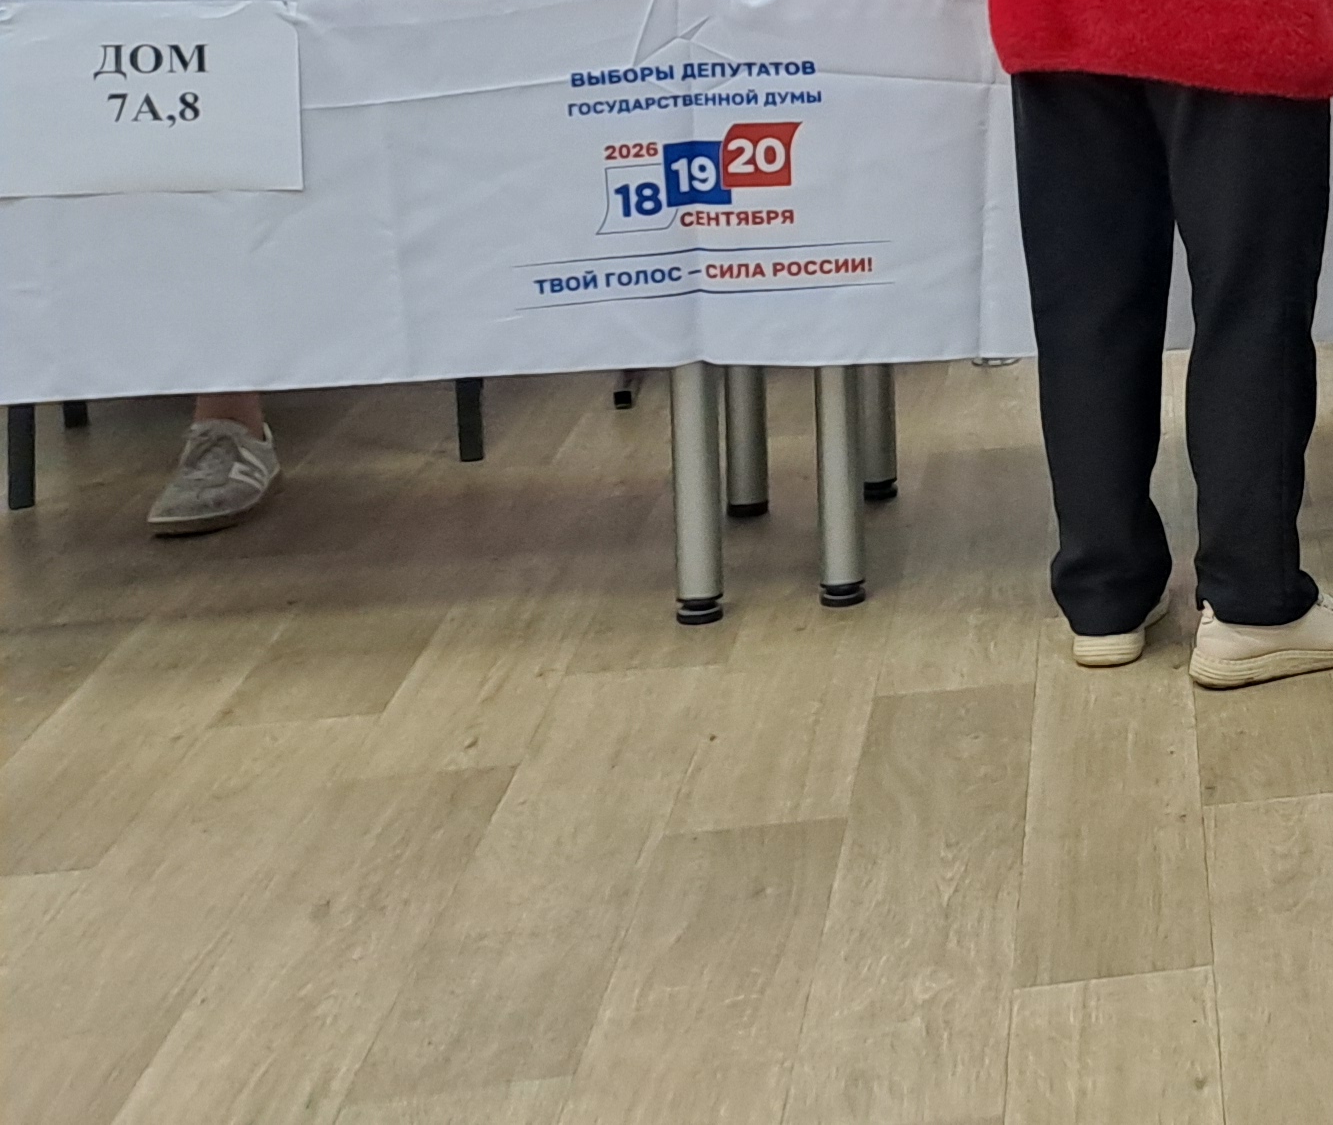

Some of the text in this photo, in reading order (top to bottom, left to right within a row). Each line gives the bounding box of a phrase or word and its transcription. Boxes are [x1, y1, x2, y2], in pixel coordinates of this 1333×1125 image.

[93, 44, 209, 81] ДОМ
[571, 61, 816, 88] ВЫБОРЫ ДЕПУТАТОВ
[107, 92, 201, 128] 7А,8
[568, 89, 822, 116] ГОСУДАРСТВЕННОЙ ДУМЫ
[604, 142, 659, 160] 2026
[614, 137, 786, 217] 18 19 20
[680, 209, 795, 228] СЕНТЯБРЯ
[534, 270, 598, 295] ТВОЙ
[605, 266, 682, 288] ГОЛОС
[705, 261, 766, 280] СИЛА
[772, 257, 873, 277] РОССИИ!
